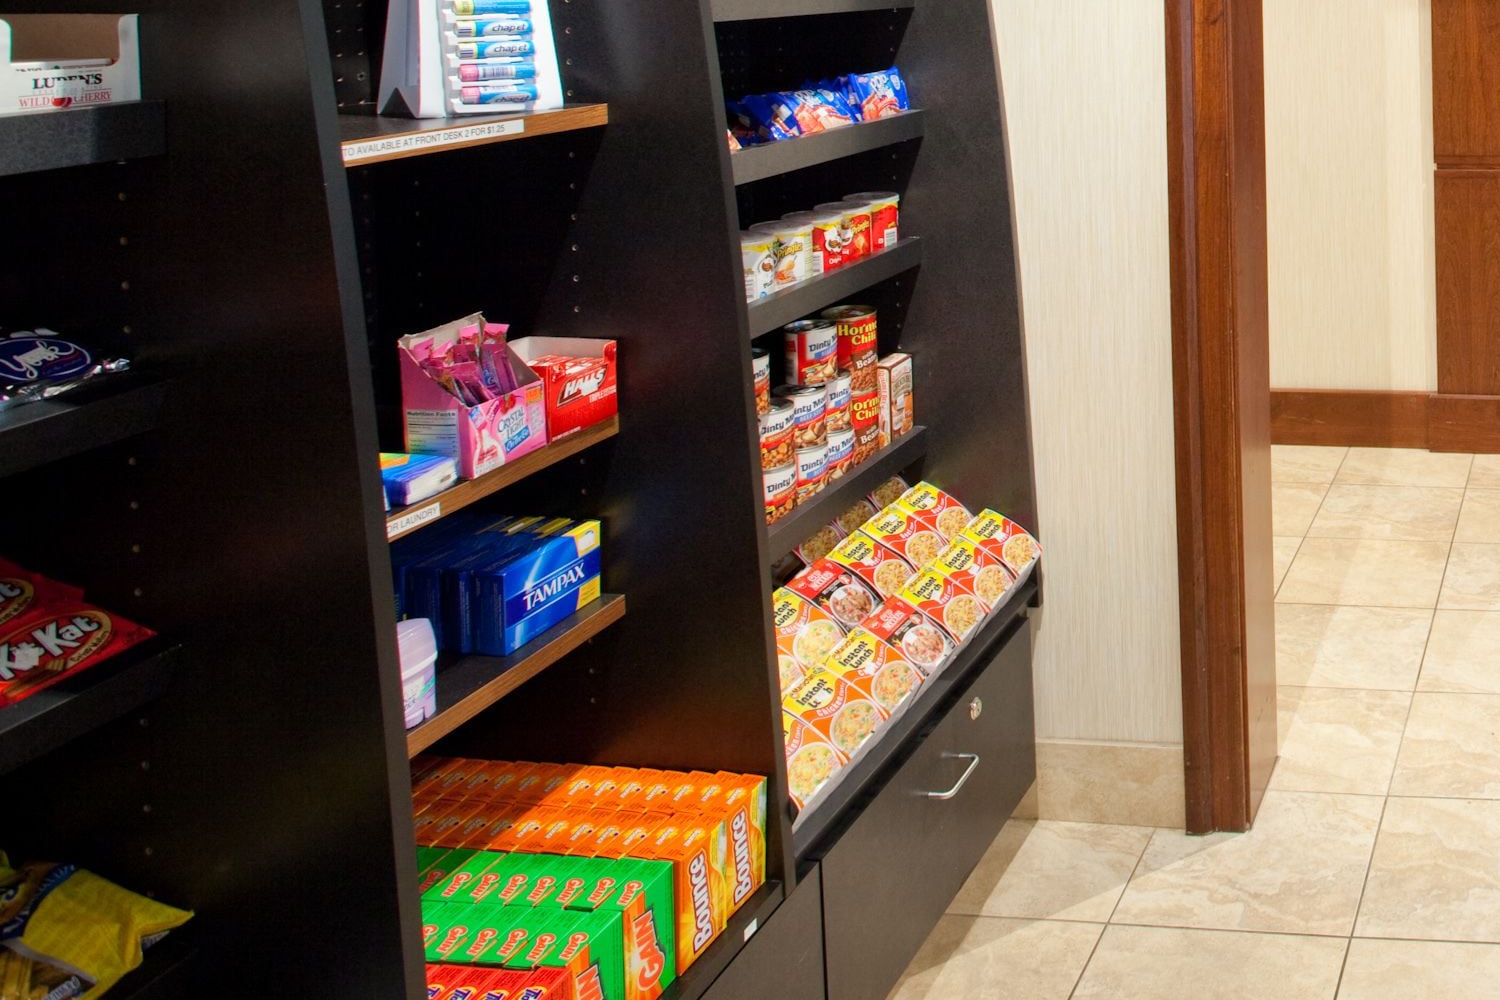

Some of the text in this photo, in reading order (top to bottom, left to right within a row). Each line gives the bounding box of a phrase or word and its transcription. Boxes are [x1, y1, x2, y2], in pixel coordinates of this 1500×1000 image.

[19, 96, 50, 108] WILD
[357, 141, 401, 155] AVAILABLE
[403, 138, 413, 146] AT
[415, 134, 441, 146] FRONT
[443, 130, 463, 141] DESK
[465, 130, 470, 138] 2
[470, 127, 486, 137] FOR
[487, 124, 505, 135] $1.25
[809, 339, 832, 352] Dinty
[801, 458, 824, 472] Dinty
[767, 478, 791, 493] Dinty
[401, 506, 438, 529] LAUNDRY
[974, 518, 997, 537] Instant
[843, 541, 867, 560] Instant
[944, 547, 968, 569] Instant
[955, 554, 973, 571] Lunch
[523, 562, 585, 611] TAMPAX
[912, 576, 937, 599] Instant
[31, 617, 100, 657] Kat
[838, 640, 868, 667] Instant
[850, 648, 874, 669] Lunch
[796, 678, 828, 706] Instant
[808, 687, 834, 708] Luh
[633, 909, 665, 991] GAIN
